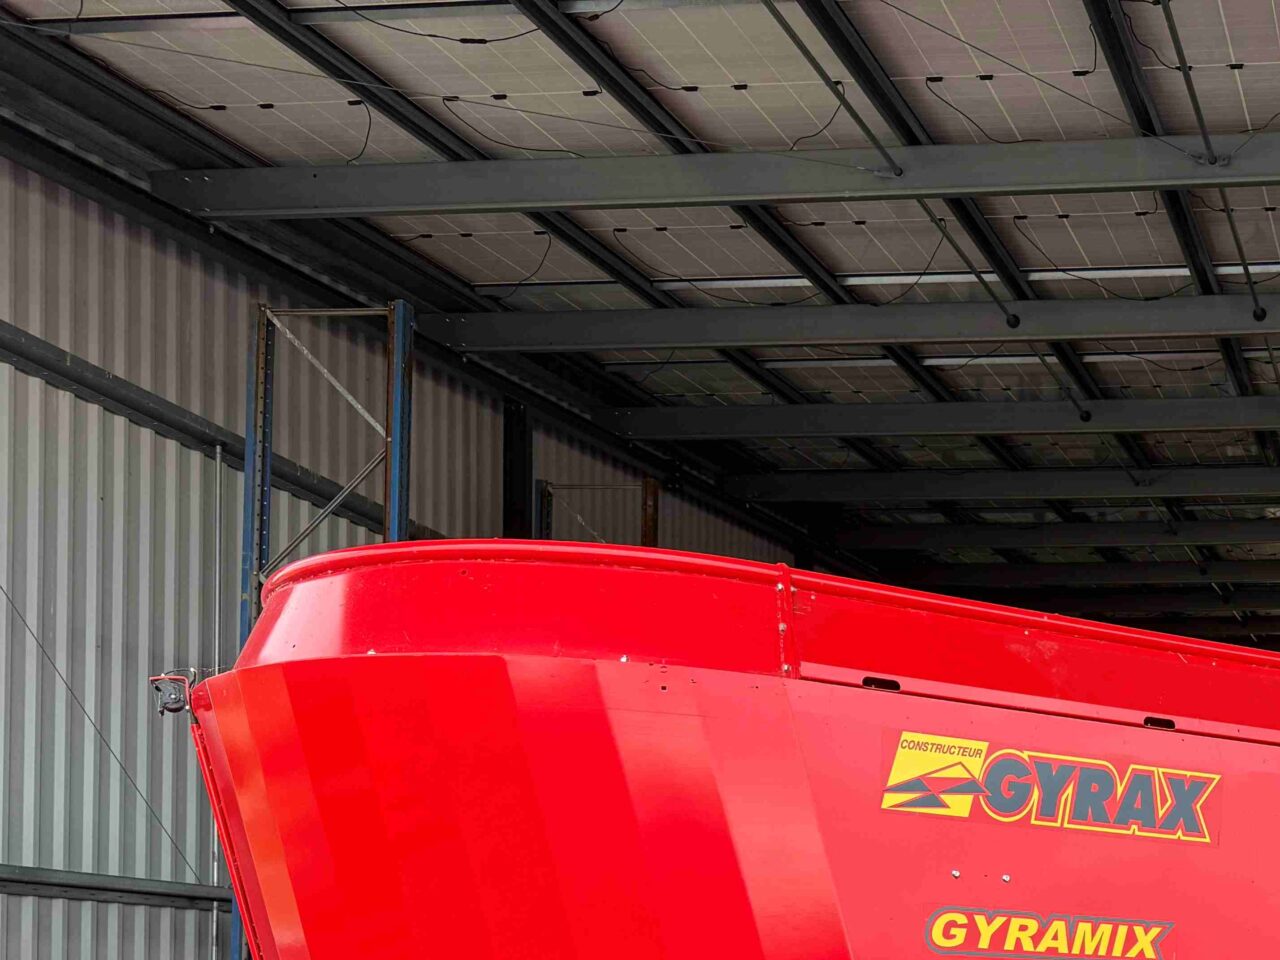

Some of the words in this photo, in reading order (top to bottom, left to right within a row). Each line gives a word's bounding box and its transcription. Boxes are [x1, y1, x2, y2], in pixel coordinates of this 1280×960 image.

[900, 738, 984, 760] CONSTRUCTEUR
[981, 754, 1213, 836] GYRAX
[930, 911, 1165, 960] GYRAMIX
